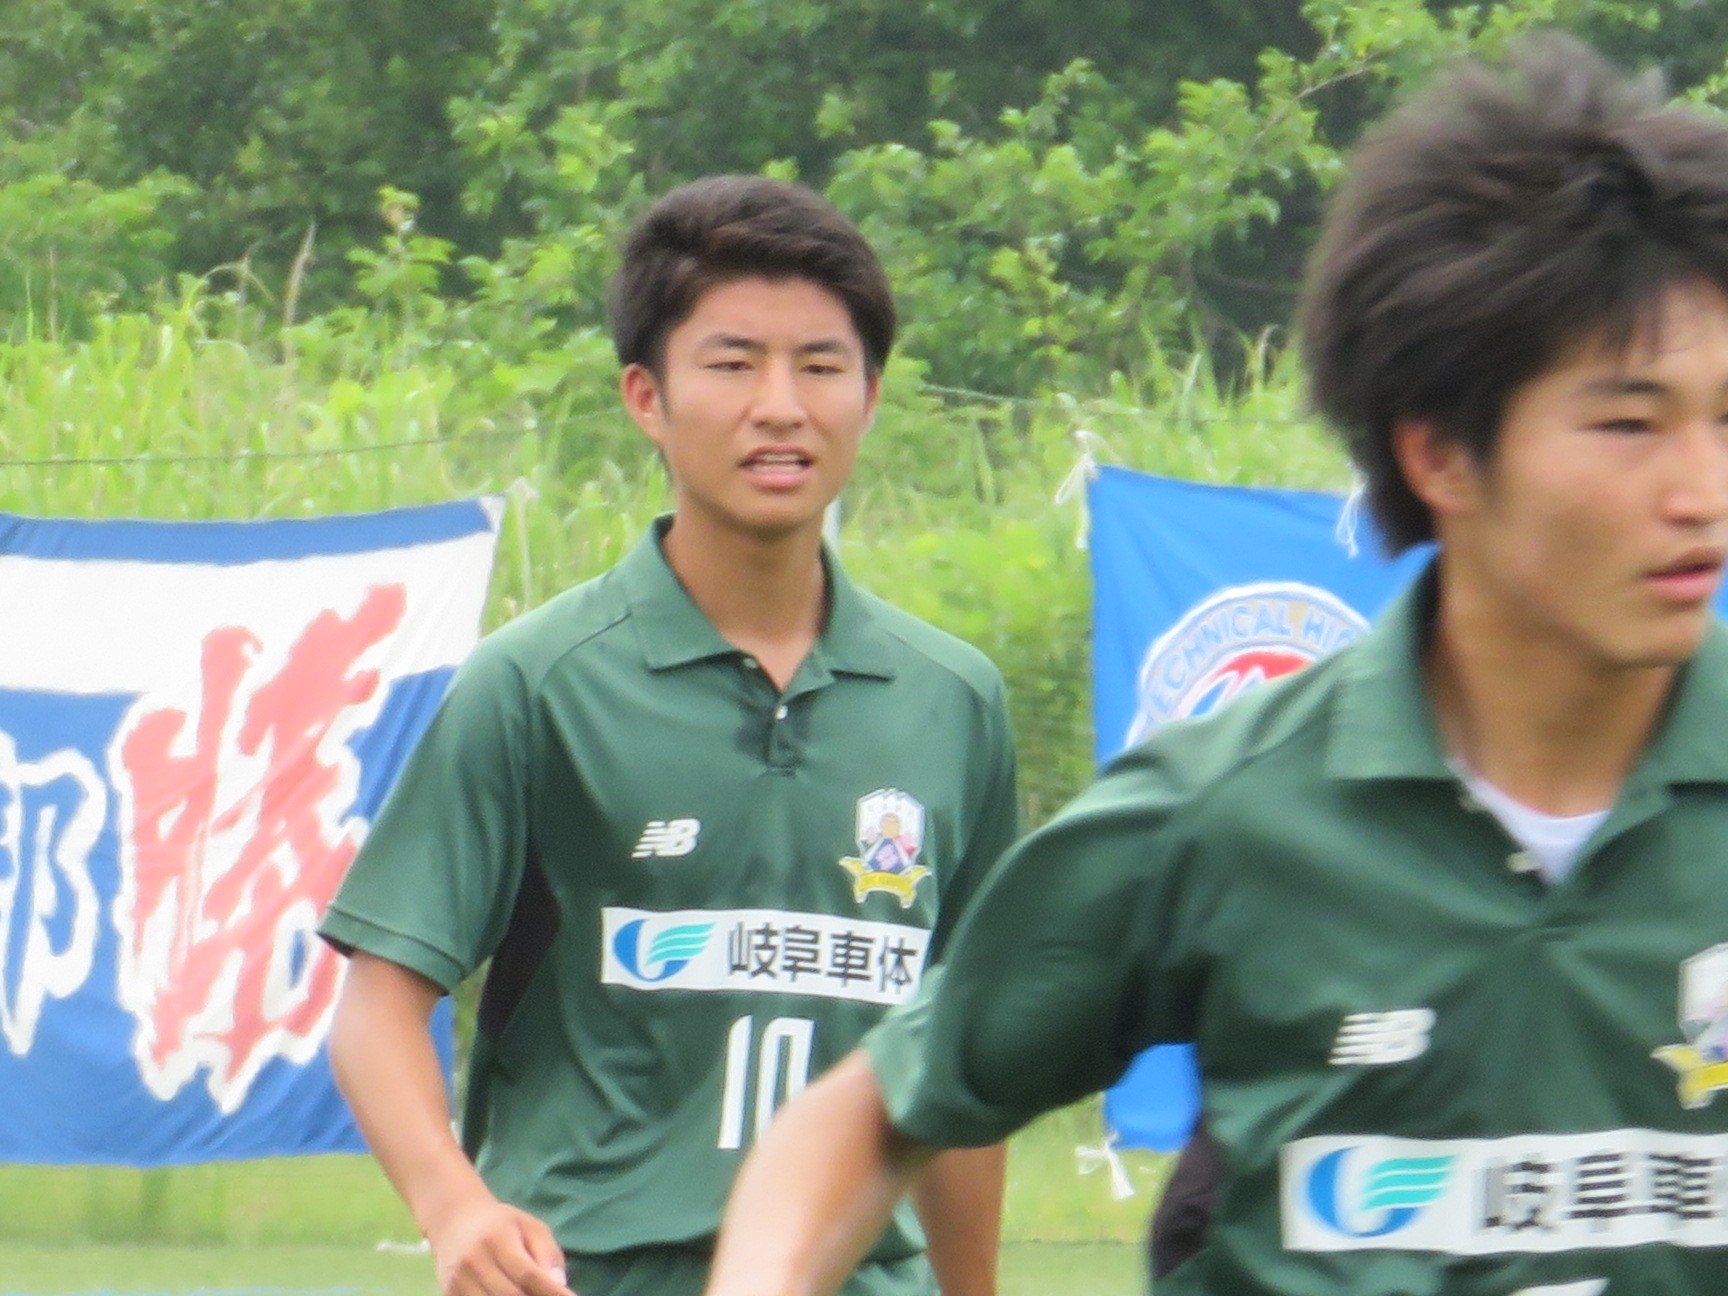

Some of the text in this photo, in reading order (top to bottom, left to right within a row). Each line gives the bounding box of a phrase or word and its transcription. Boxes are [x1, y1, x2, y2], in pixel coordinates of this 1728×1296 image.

[728, 921, 920, 994] 岐阜車体
[717, 1015, 814, 1150] 10
